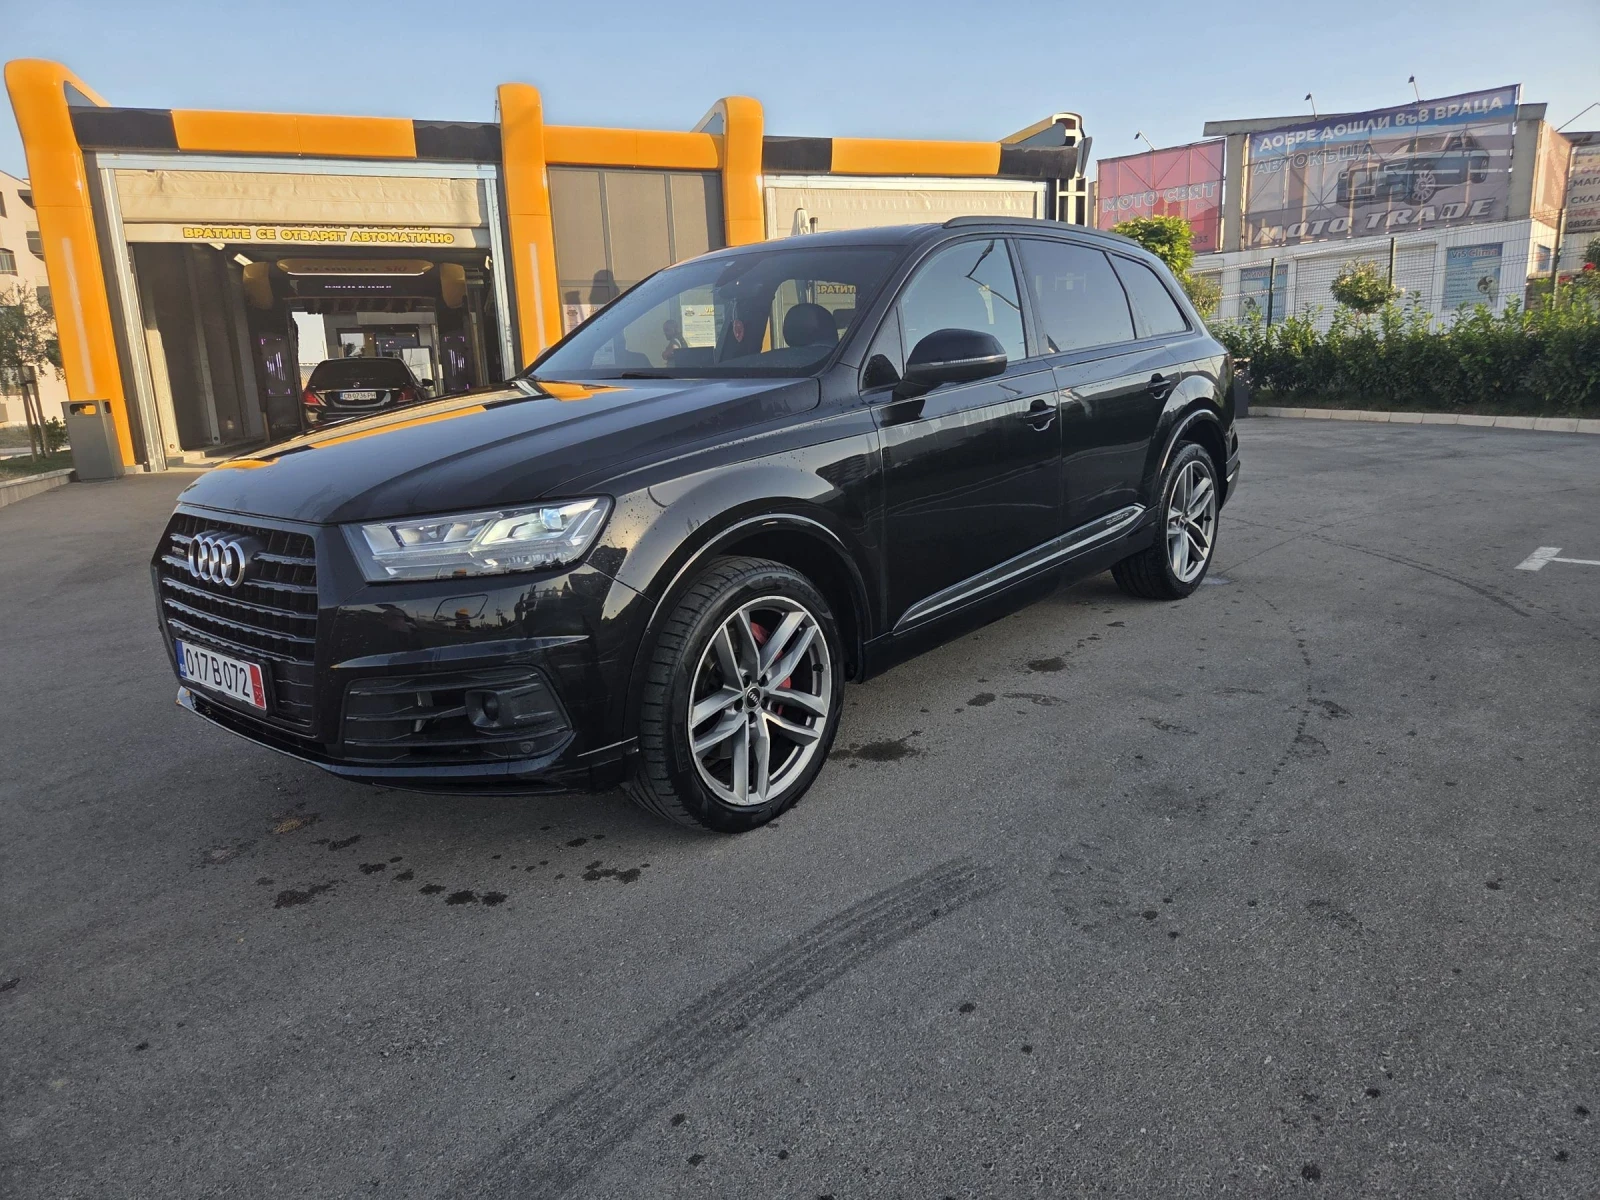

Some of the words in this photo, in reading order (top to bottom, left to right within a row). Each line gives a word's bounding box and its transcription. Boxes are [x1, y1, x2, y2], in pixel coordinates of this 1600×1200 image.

[1260, 128, 1317, 152] ДОБРЕ
[1320, 115, 1390, 140] ДОШЛИ
[1434, 97, 1503, 120] ВРАЦА
[1253, 142, 1377, 176] АВТОКЪЩА
[1102, 189, 1159, 213] МОТО
[1163, 181, 1218, 203] СВЯТ
[1573, 177, 1600, 186] МАГ
[183, 227, 251, 240] ВРАТИТЕ
[256, 229, 276, 240] СЕ
[280, 230, 347, 241] ОТВАРЯТ
[350, 231, 454, 244] АВТОМАТИЧНО
[1253, 216, 1353, 243] MOTO
[1366, 198, 1496, 229] TRADE
[817, 284, 856, 294] РАТИТ
